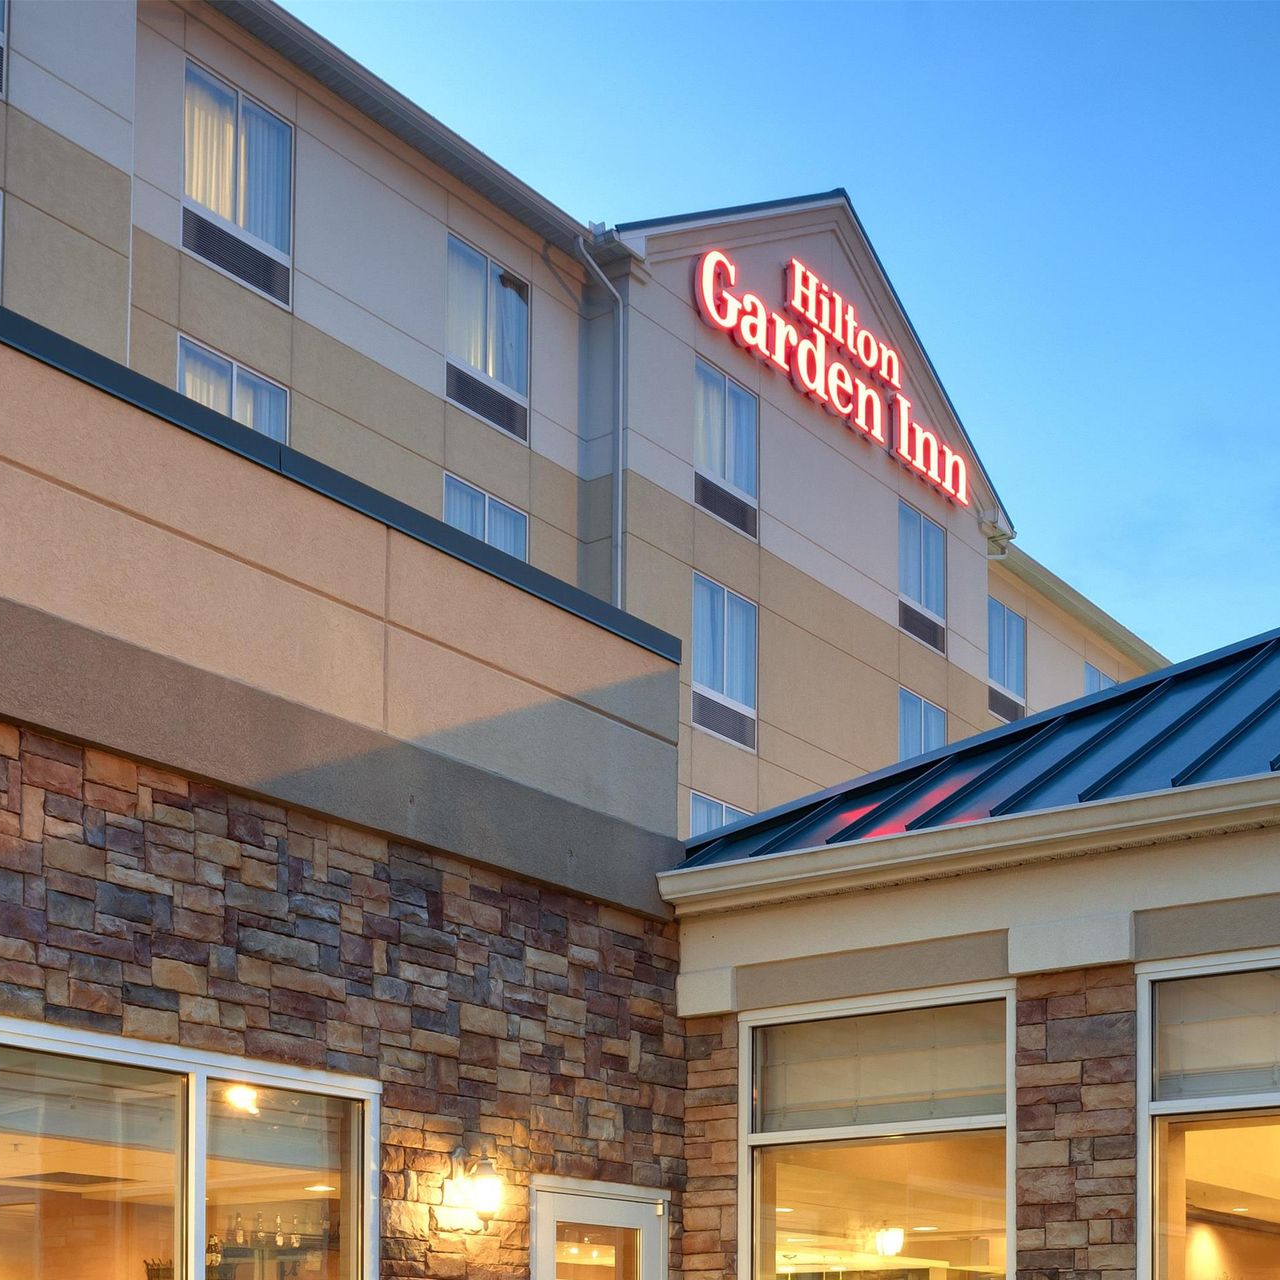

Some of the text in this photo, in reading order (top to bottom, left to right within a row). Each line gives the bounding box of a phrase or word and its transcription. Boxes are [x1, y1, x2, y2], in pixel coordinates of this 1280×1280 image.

[699, 249, 969, 506] Garden Inn
[789, 257, 902, 389] Hilton
